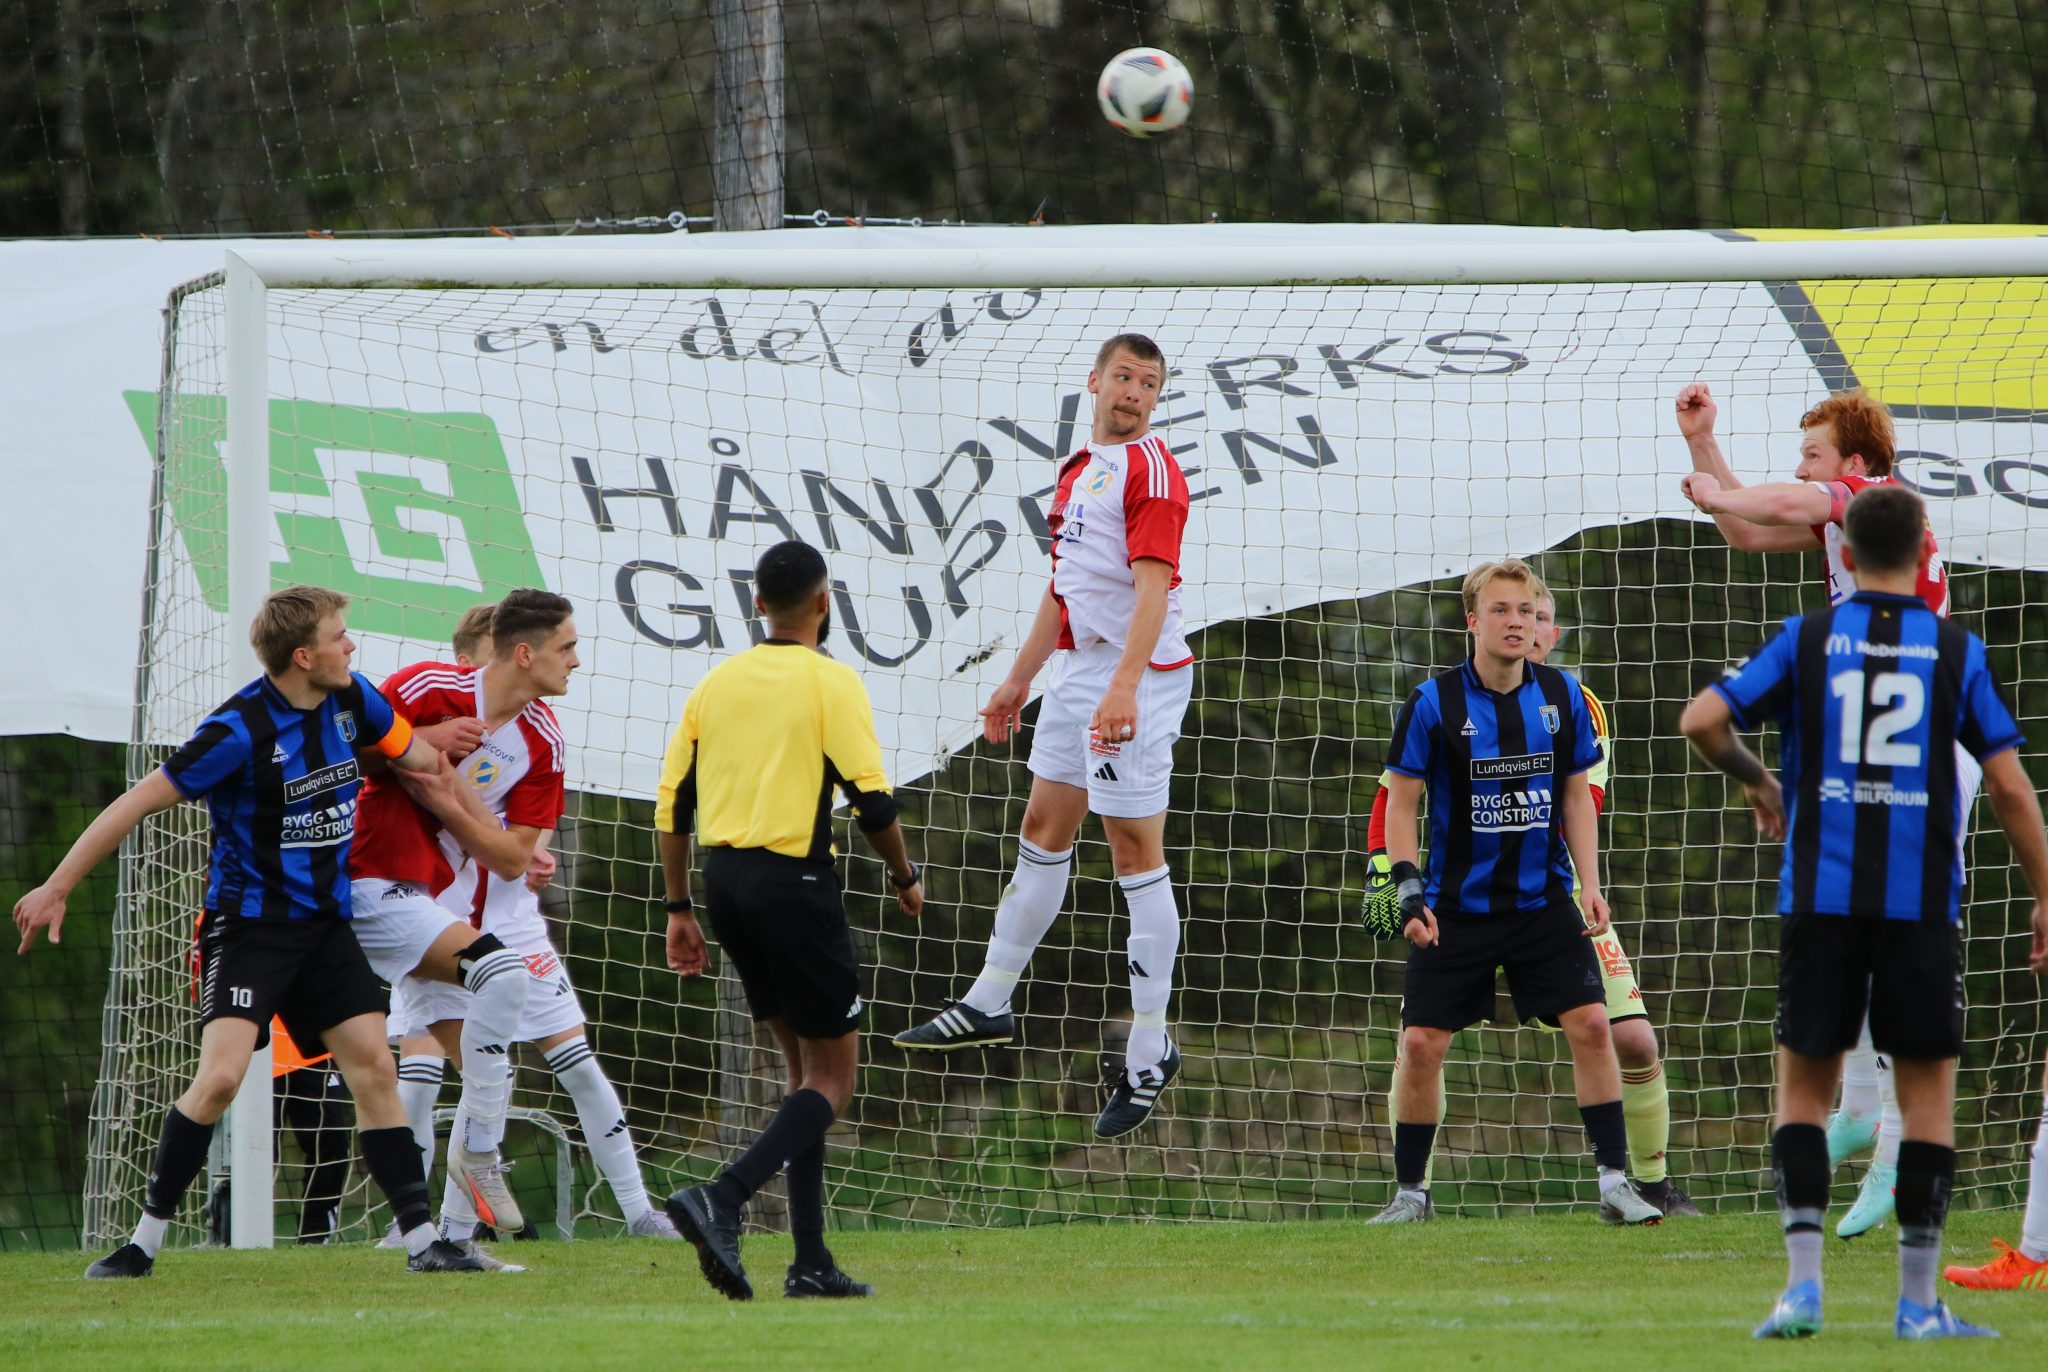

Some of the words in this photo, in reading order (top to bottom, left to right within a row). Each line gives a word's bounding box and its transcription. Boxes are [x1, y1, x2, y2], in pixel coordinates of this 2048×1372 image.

[474, 321, 625, 353] en
[1856, 640, 1939, 661] McDonald's
[1831, 669, 1925, 767] 12
[1461, 729, 1479, 737] SELECT
[271, 753, 290, 764] SELECT
[1476, 760, 1531, 774] Lundqvist
[290, 771, 335, 797] Lundqvist
[1471, 793, 1511, 808] BYGG
[1854, 788, 1930, 808] BILFORUM
[282, 811, 324, 828] BYGG
[1471, 804, 1553, 824] CONSTRUCT
[281, 814, 355, 840] CONSTRUC
[230, 986, 252, 1008] 10
